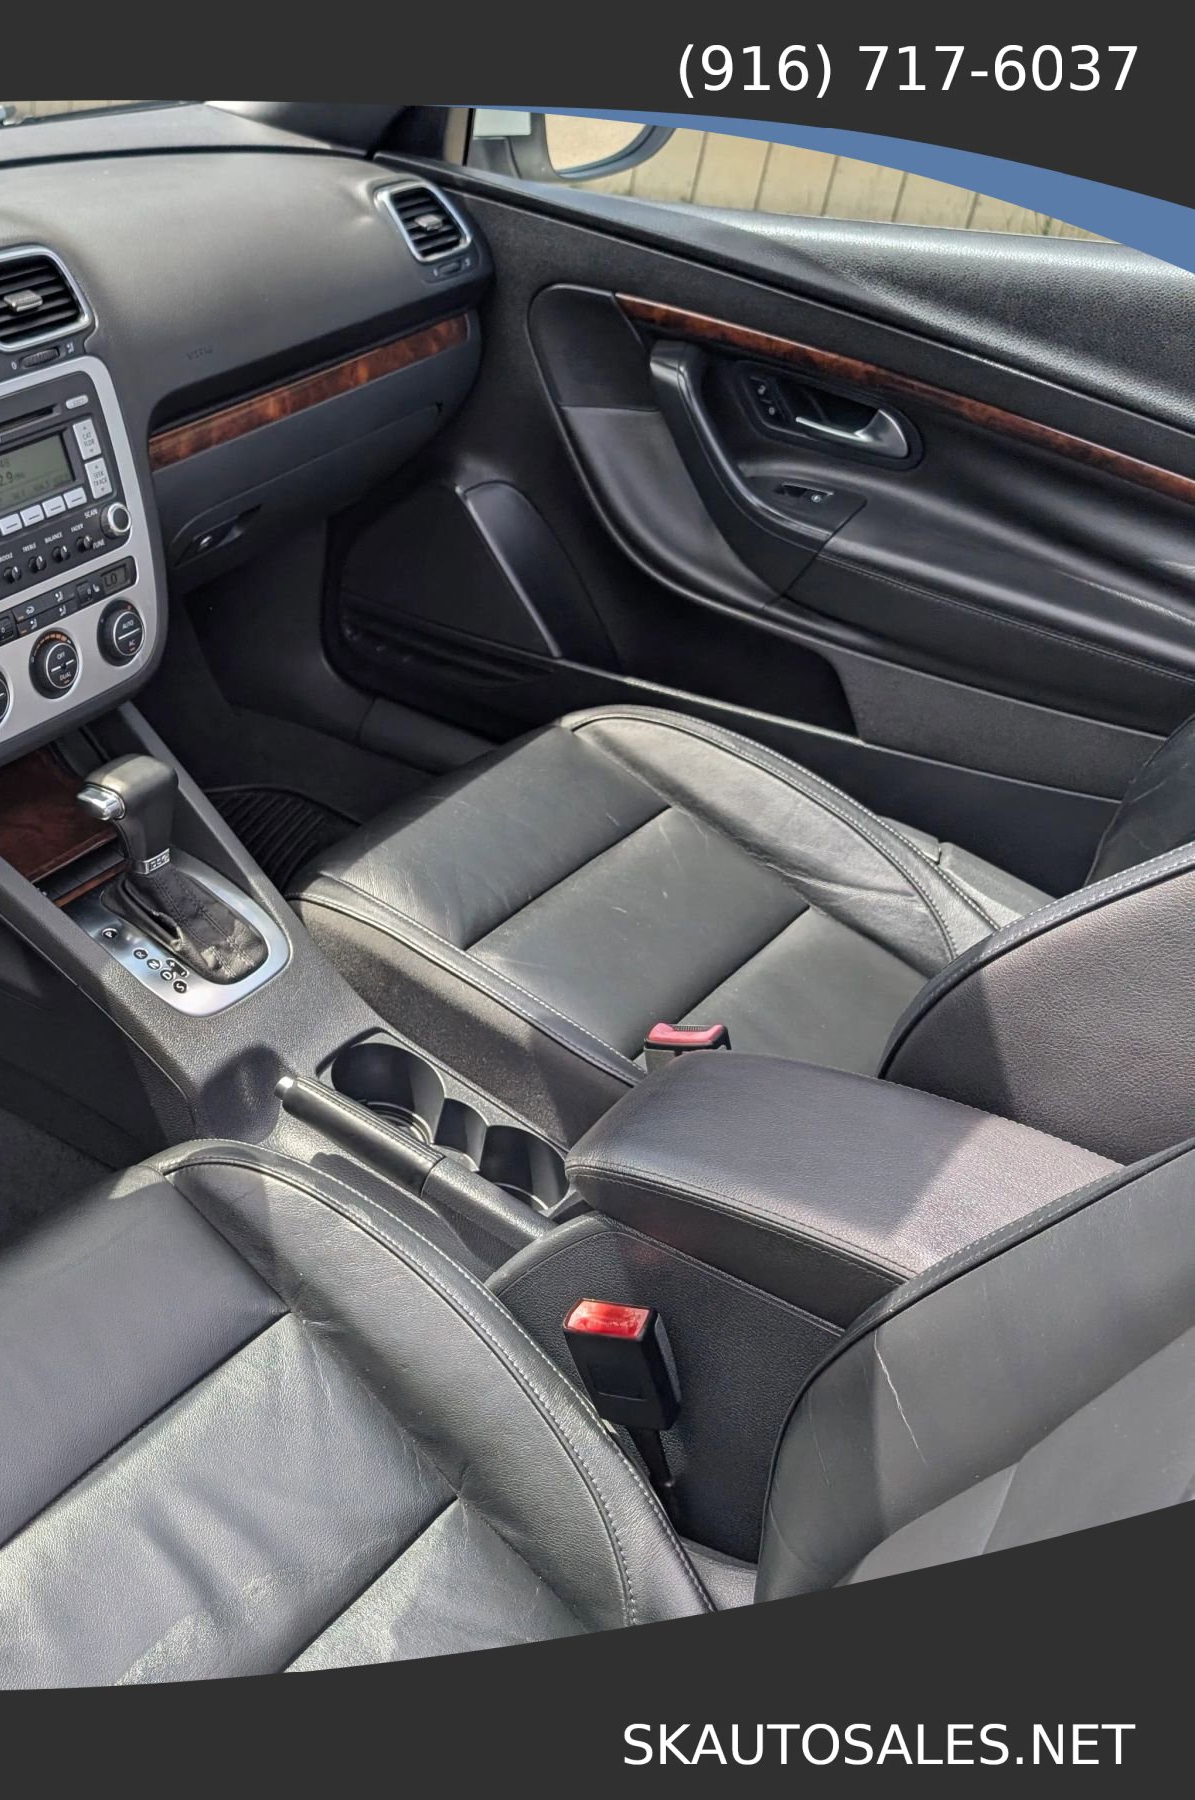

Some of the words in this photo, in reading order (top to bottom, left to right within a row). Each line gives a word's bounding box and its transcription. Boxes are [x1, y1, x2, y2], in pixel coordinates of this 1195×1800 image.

[84, 508, 98, 519] SCAN
[44, 531, 64, 544] BALANCE
[122, 620, 135, 630] AUTO
[148, 960, 160, 969] N
[162, 971, 172, 980] D
[176, 983, 185, 992] S
